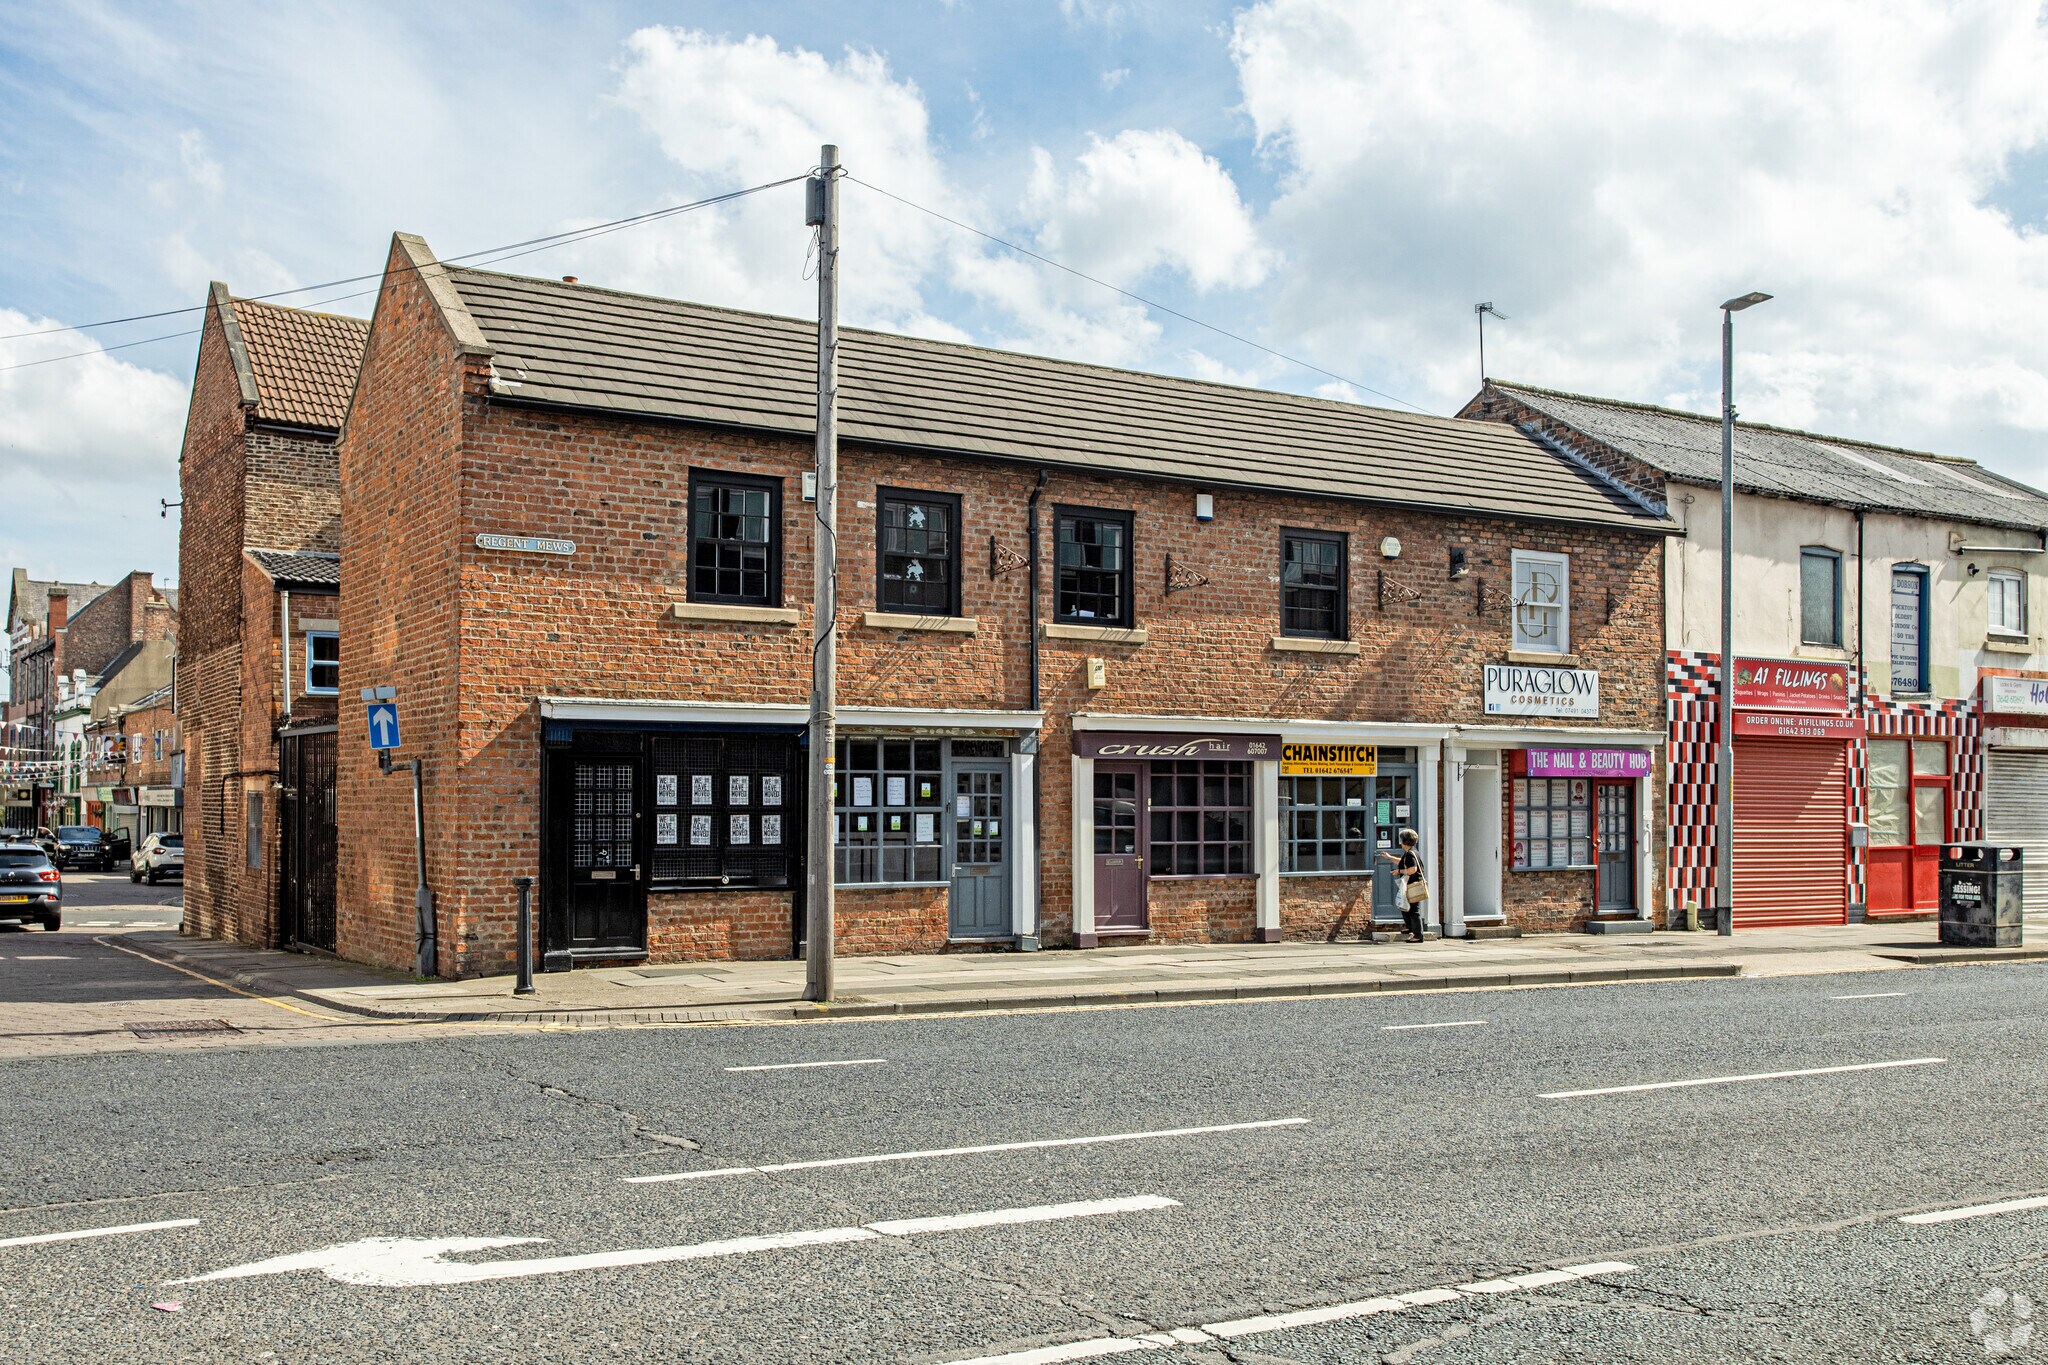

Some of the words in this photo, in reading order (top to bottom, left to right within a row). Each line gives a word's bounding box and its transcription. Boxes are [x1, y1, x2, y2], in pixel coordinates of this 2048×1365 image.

[483, 537, 528, 548] REGENT
[537, 541, 569, 551] MEWS
[1897, 579, 1918, 590] DOBSON
[1488, 668, 1595, 694] PURAGLOW
[1753, 667, 1770, 685] A1
[1776, 668, 1828, 690] FILLINGS
[1512, 695, 1575, 706] COSMETICS
[1735, 689, 1753, 697] Baguettes
[1770, 718, 1796, 726] ONLINE:
[1798, 718, 1854, 728] A1FILLINGS.CO.UK
[1098, 738, 1222, 756] crush
[1208, 742, 1231, 751] hair
[1282, 745, 1375, 762] CHAINSTITCH
[1531, 752, 1548, 768] THE
[1554, 753, 1574, 768] NAIL
[1579, 753, 1586, 768] &
[1592, 753, 1625, 769] BEAUTY
[1630, 754, 1647, 769] HUB
